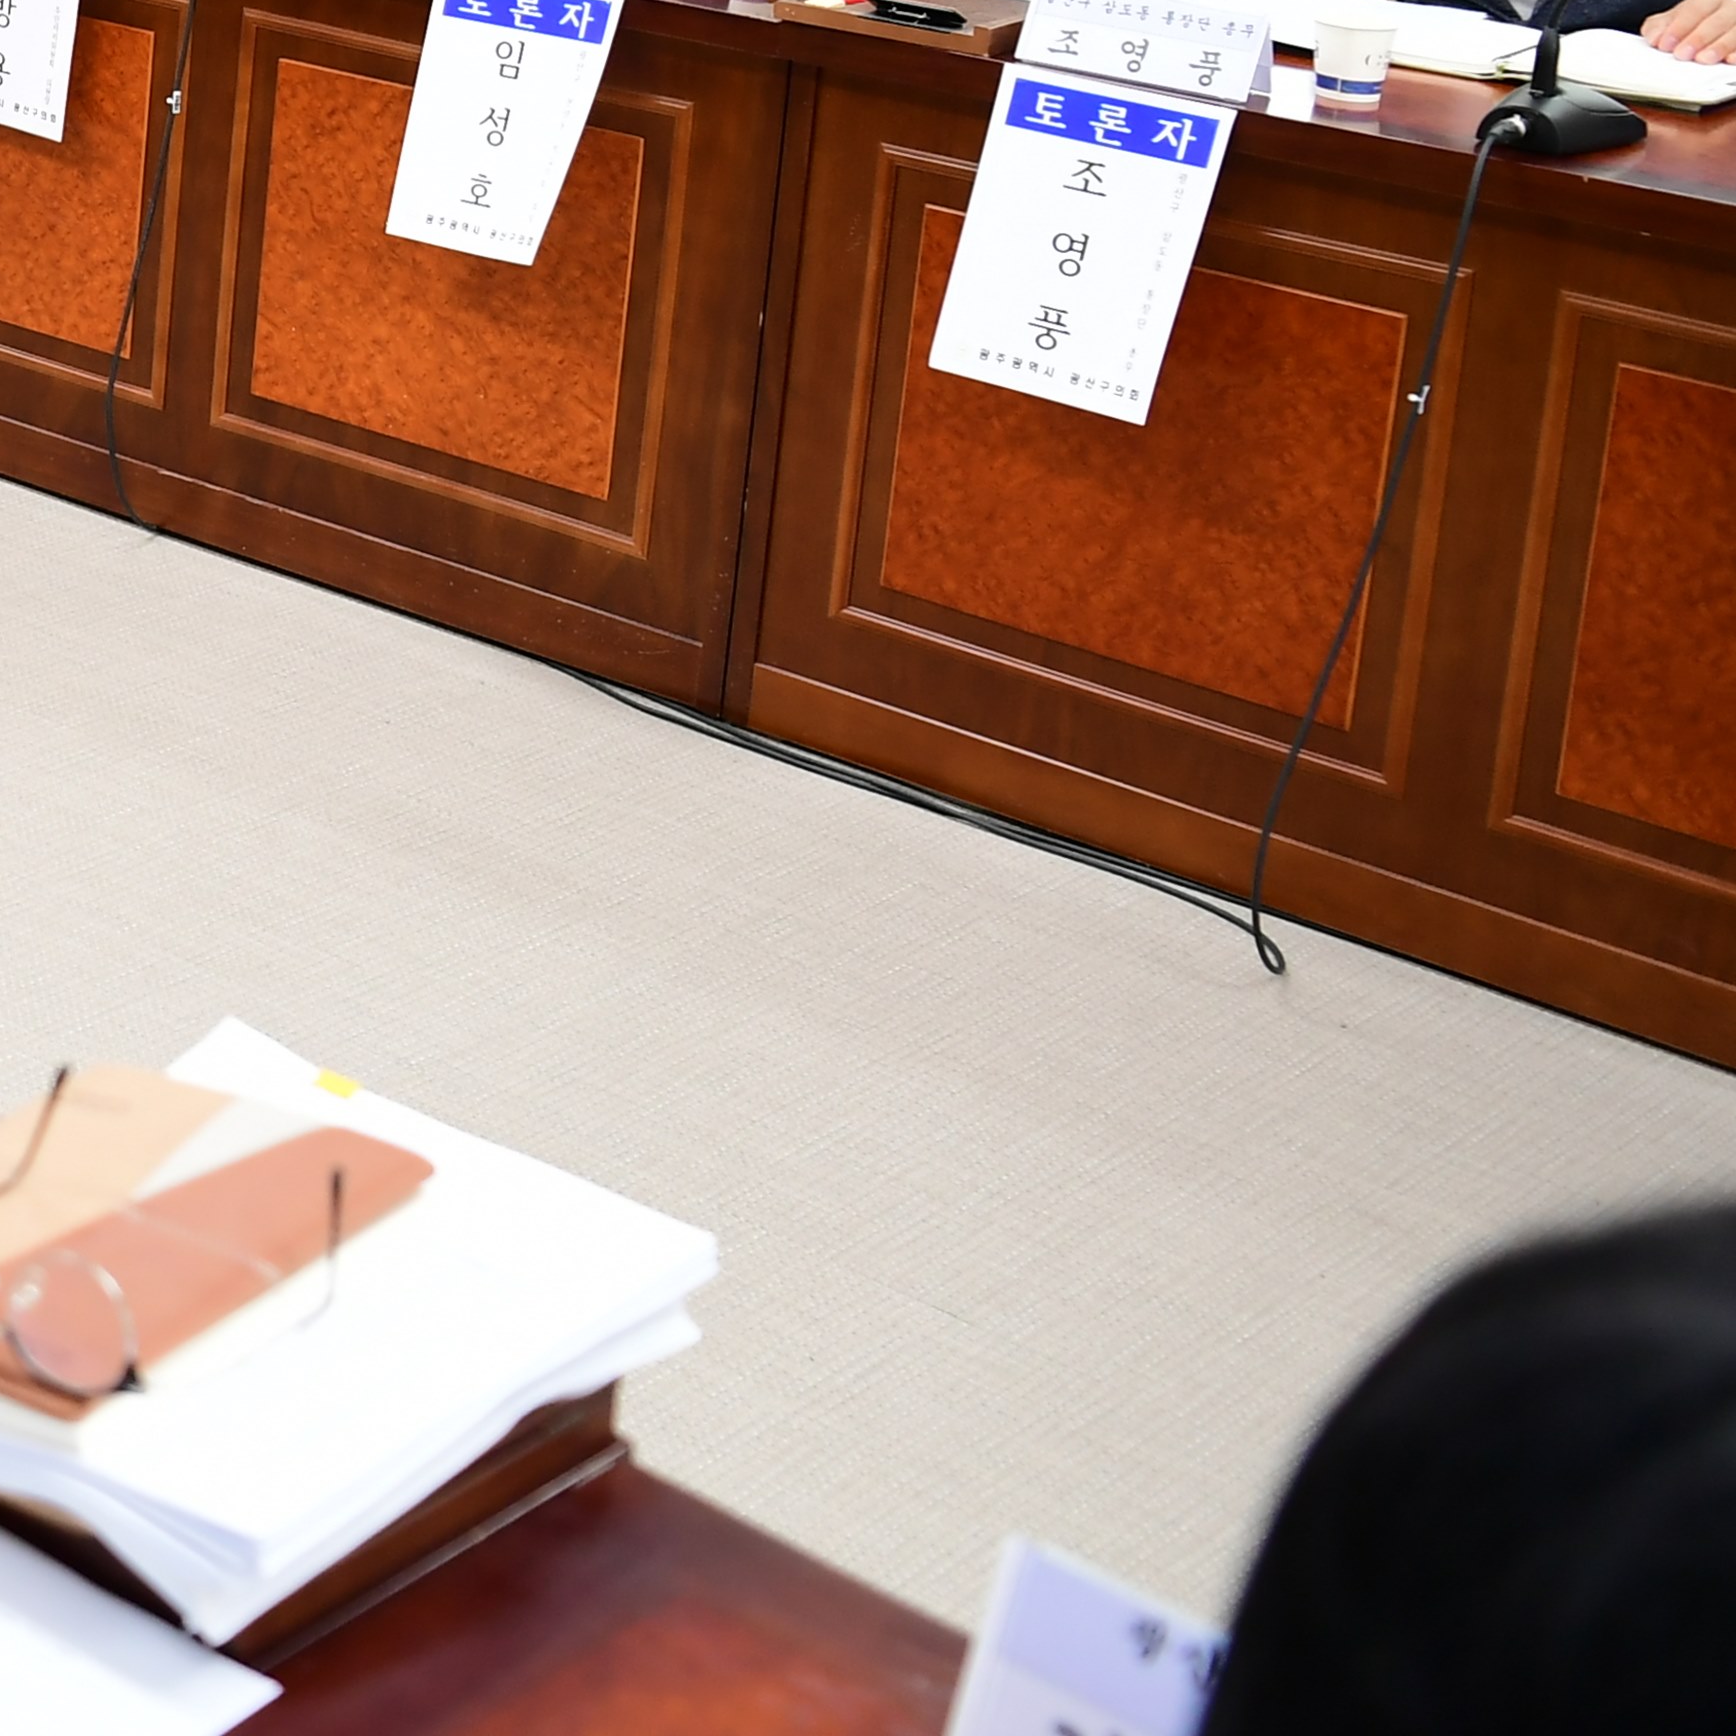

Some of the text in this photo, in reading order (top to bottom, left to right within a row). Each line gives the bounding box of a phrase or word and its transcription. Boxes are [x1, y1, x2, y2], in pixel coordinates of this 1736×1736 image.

[1104, 0, 1150, 21] 삼도동
[1161, 10, 1211, 32] 통장단
[1047, 29, 1224, 87] 조영풍
[460, 41, 526, 209] 임성호
[1023, 91, 1198, 161] 토론자
[1027, 158, 1109, 351] 조영풍
[978, 347, 1140, 402] 광주광역시 광산구의회
